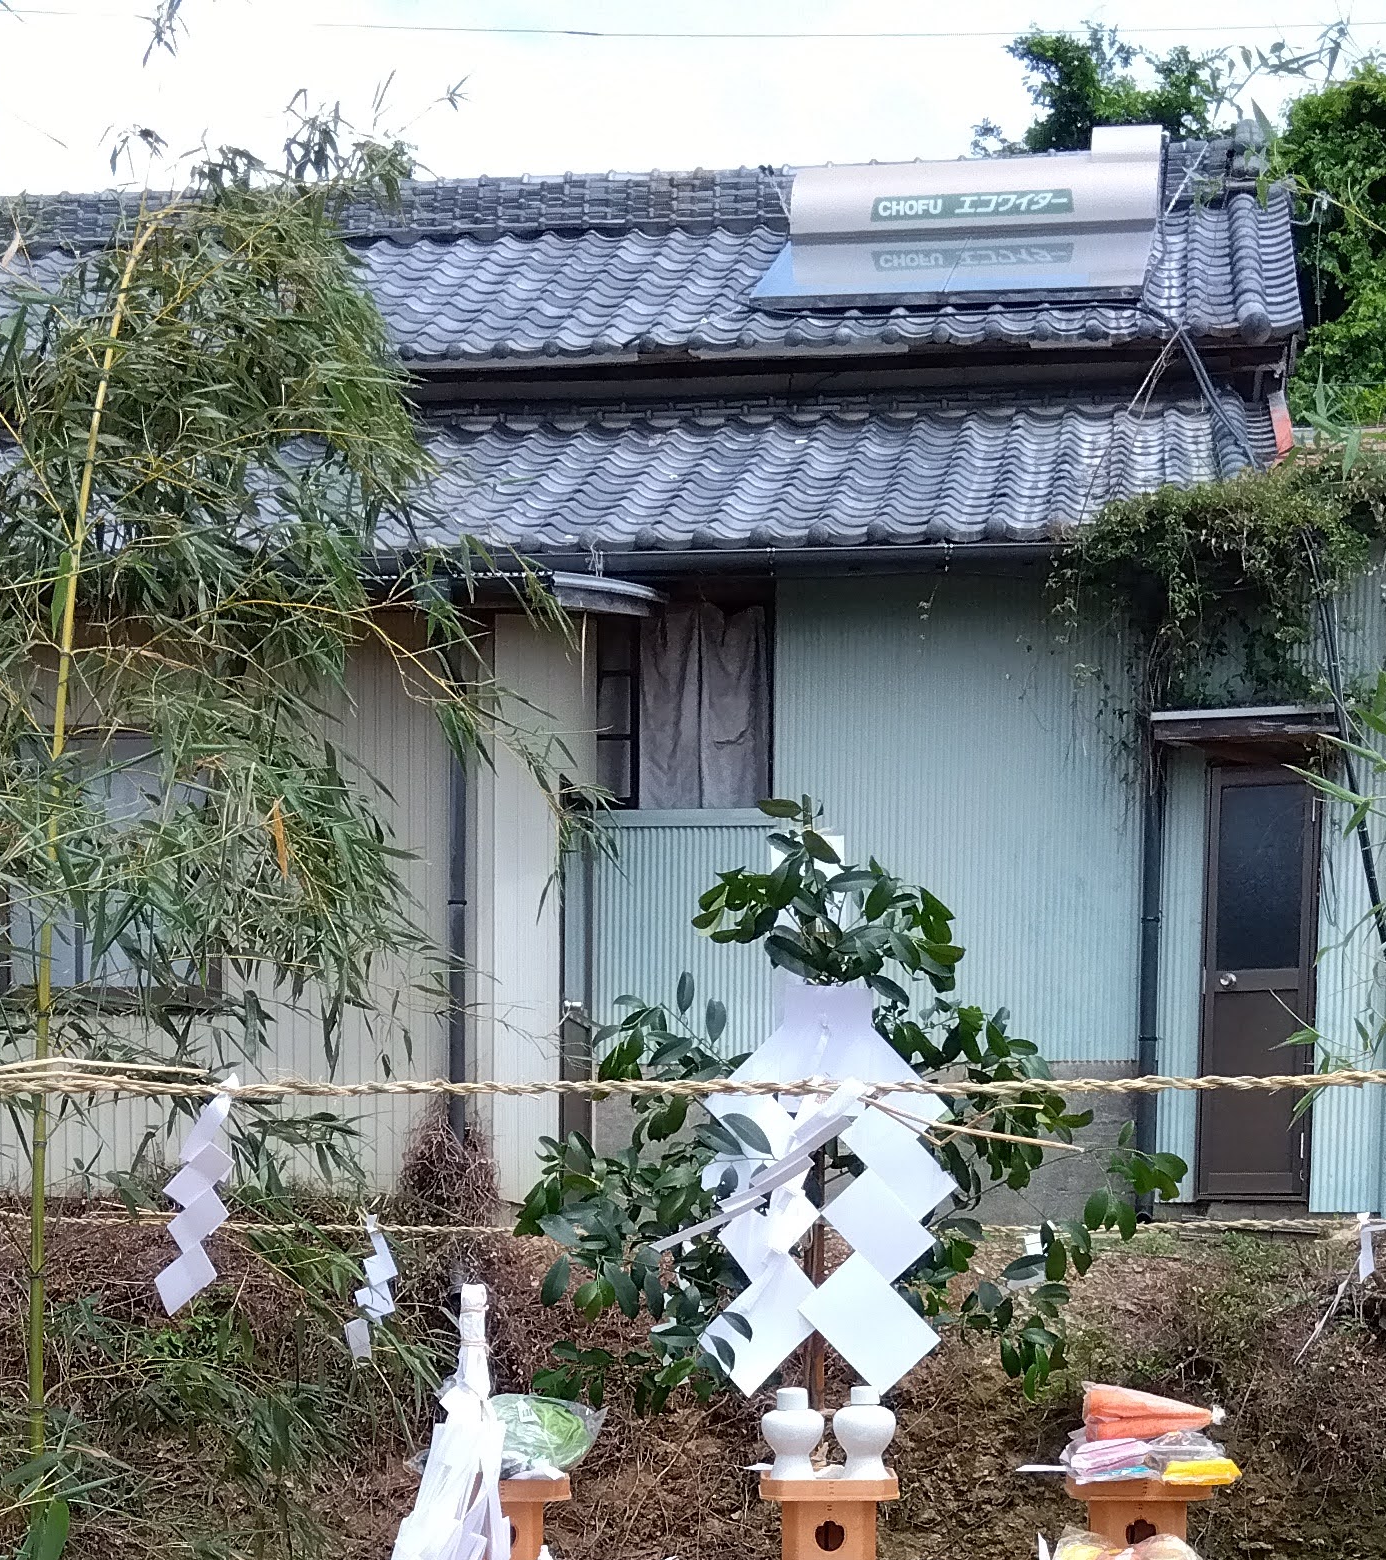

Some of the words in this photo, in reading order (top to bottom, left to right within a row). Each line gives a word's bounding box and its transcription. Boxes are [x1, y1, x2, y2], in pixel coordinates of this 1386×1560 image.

[878, 198, 943, 216] CHOFU
[954, 193, 1068, 214] エコワイター
